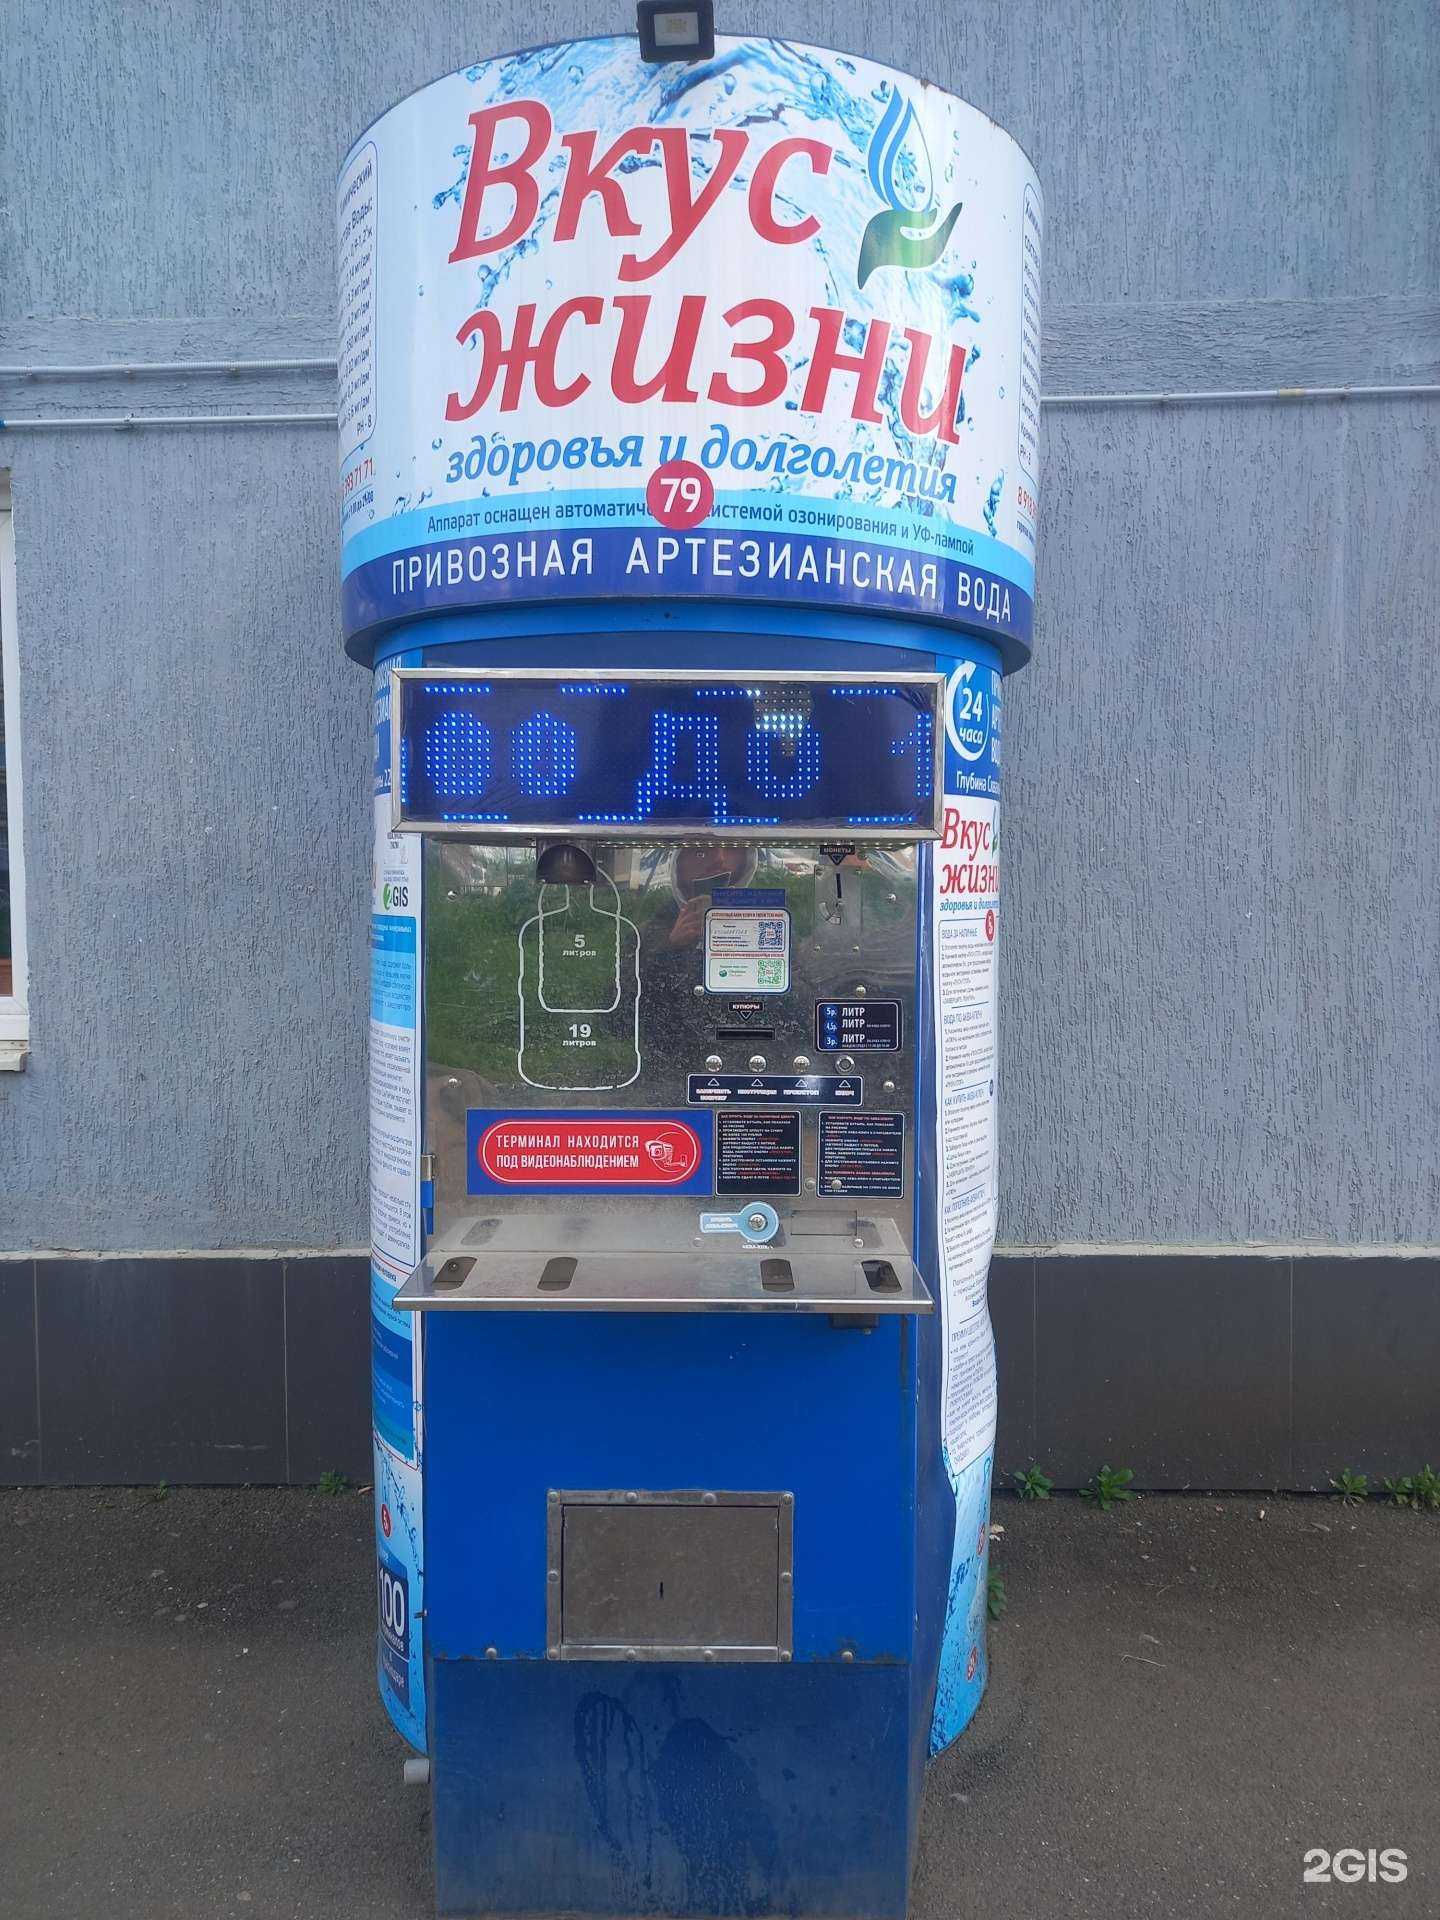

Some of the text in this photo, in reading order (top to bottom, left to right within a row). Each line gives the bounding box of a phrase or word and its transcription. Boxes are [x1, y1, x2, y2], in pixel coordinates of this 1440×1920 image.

[448, 98, 834, 283] Вкус
[444, 295, 967, 445] жизни
[364, 457, 374, 481] 71
[446, 423, 958, 505] здоровья и долголетия
[659, 476, 702, 514] 79
[427, 501, 974, 557] Аппарат оснащен автоматич истемой озонирования и УФ-лампой
[392, 536, 1012, 623] ПРИВОЗНАЯ АРТЕЗИАНСКАЯ ВОДА
[960, 687, 983, 722] 24
[960, 728, 983, 745] часа
[956, 771, 987, 794] Глубина
[941, 808, 991, 861] Вкус
[940, 898, 973, 914] здоровья
[574, 934, 586, 949] 5
[562, 950, 597, 958] литров
[842, 1007, 866, 1017] ЛИТР
[569, 1024, 592, 1038] 19
[842, 1019, 866, 1029] ЛИТР
[562, 1039, 597, 1048] литров
[842, 1034, 866, 1043] ЛИТР
[496, 1135, 640, 1149] ТЕРМИНАЛ НАХОДИТСЯ
[496, 1154, 640, 1168] ПОД ВИДЕОНАБЛЮДЕНИЕМ
[379, 1567, 405, 1637] 100
